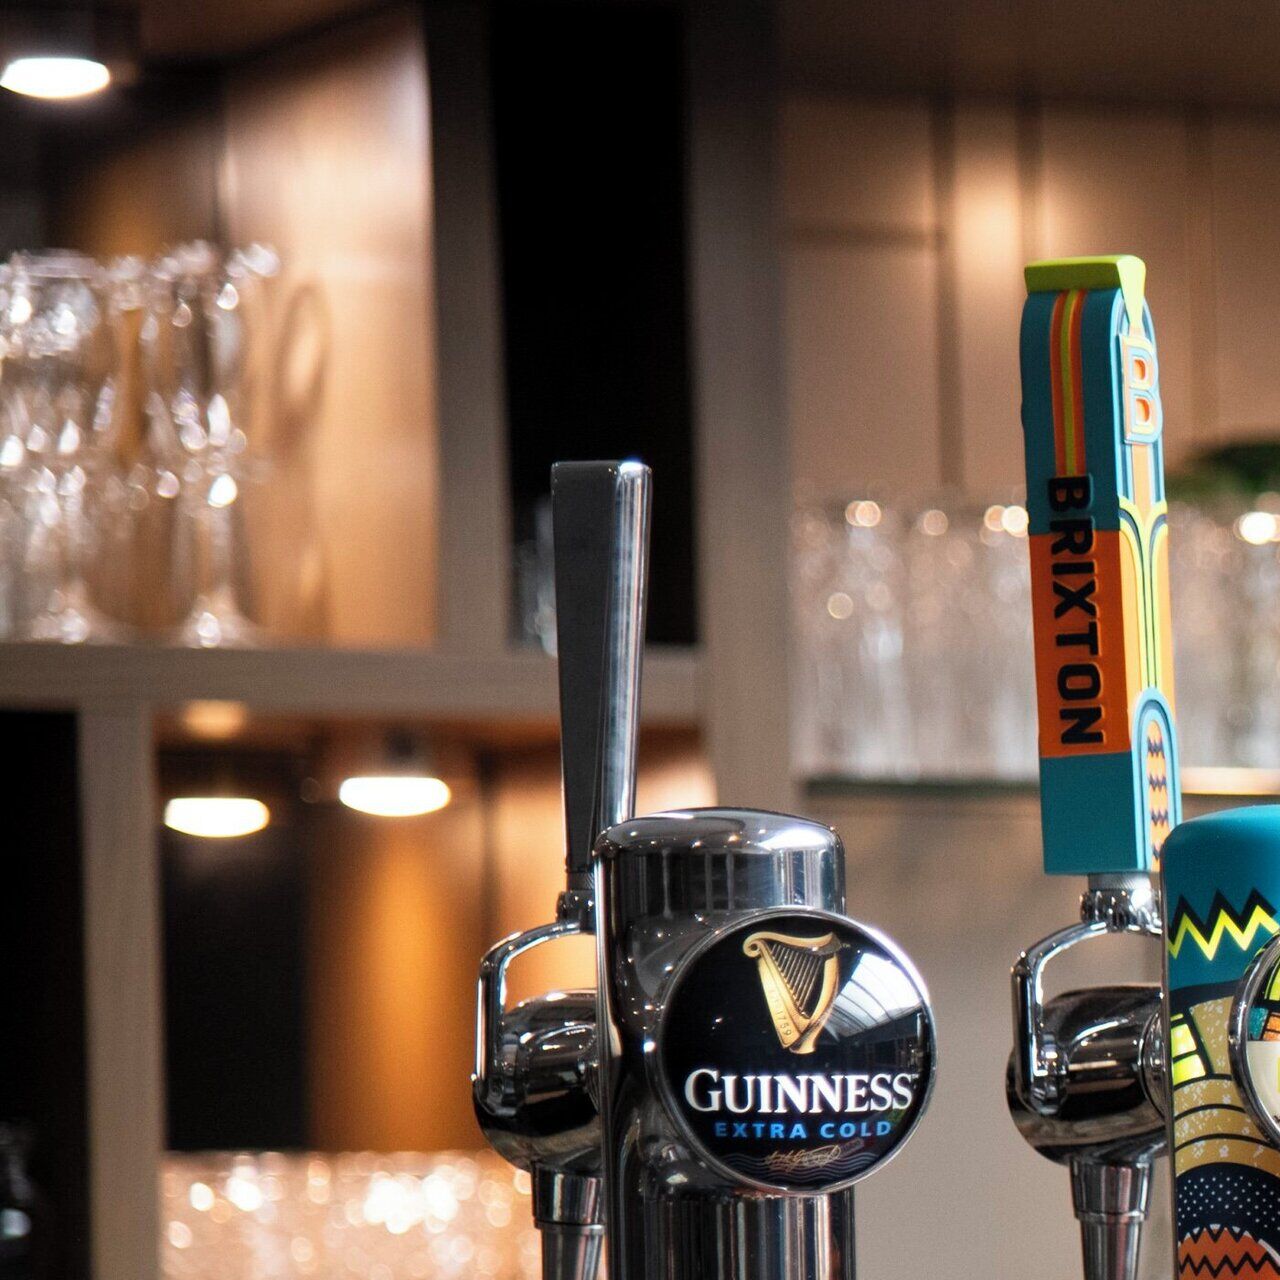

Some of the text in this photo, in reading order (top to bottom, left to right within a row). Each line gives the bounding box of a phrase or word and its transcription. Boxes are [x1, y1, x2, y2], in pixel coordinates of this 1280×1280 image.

[1047, 474, 1105, 746] BRIXTON
[684, 1068, 914, 1114] GUINNESS
[715, 1120, 892, 1140] EXTRA COLD
